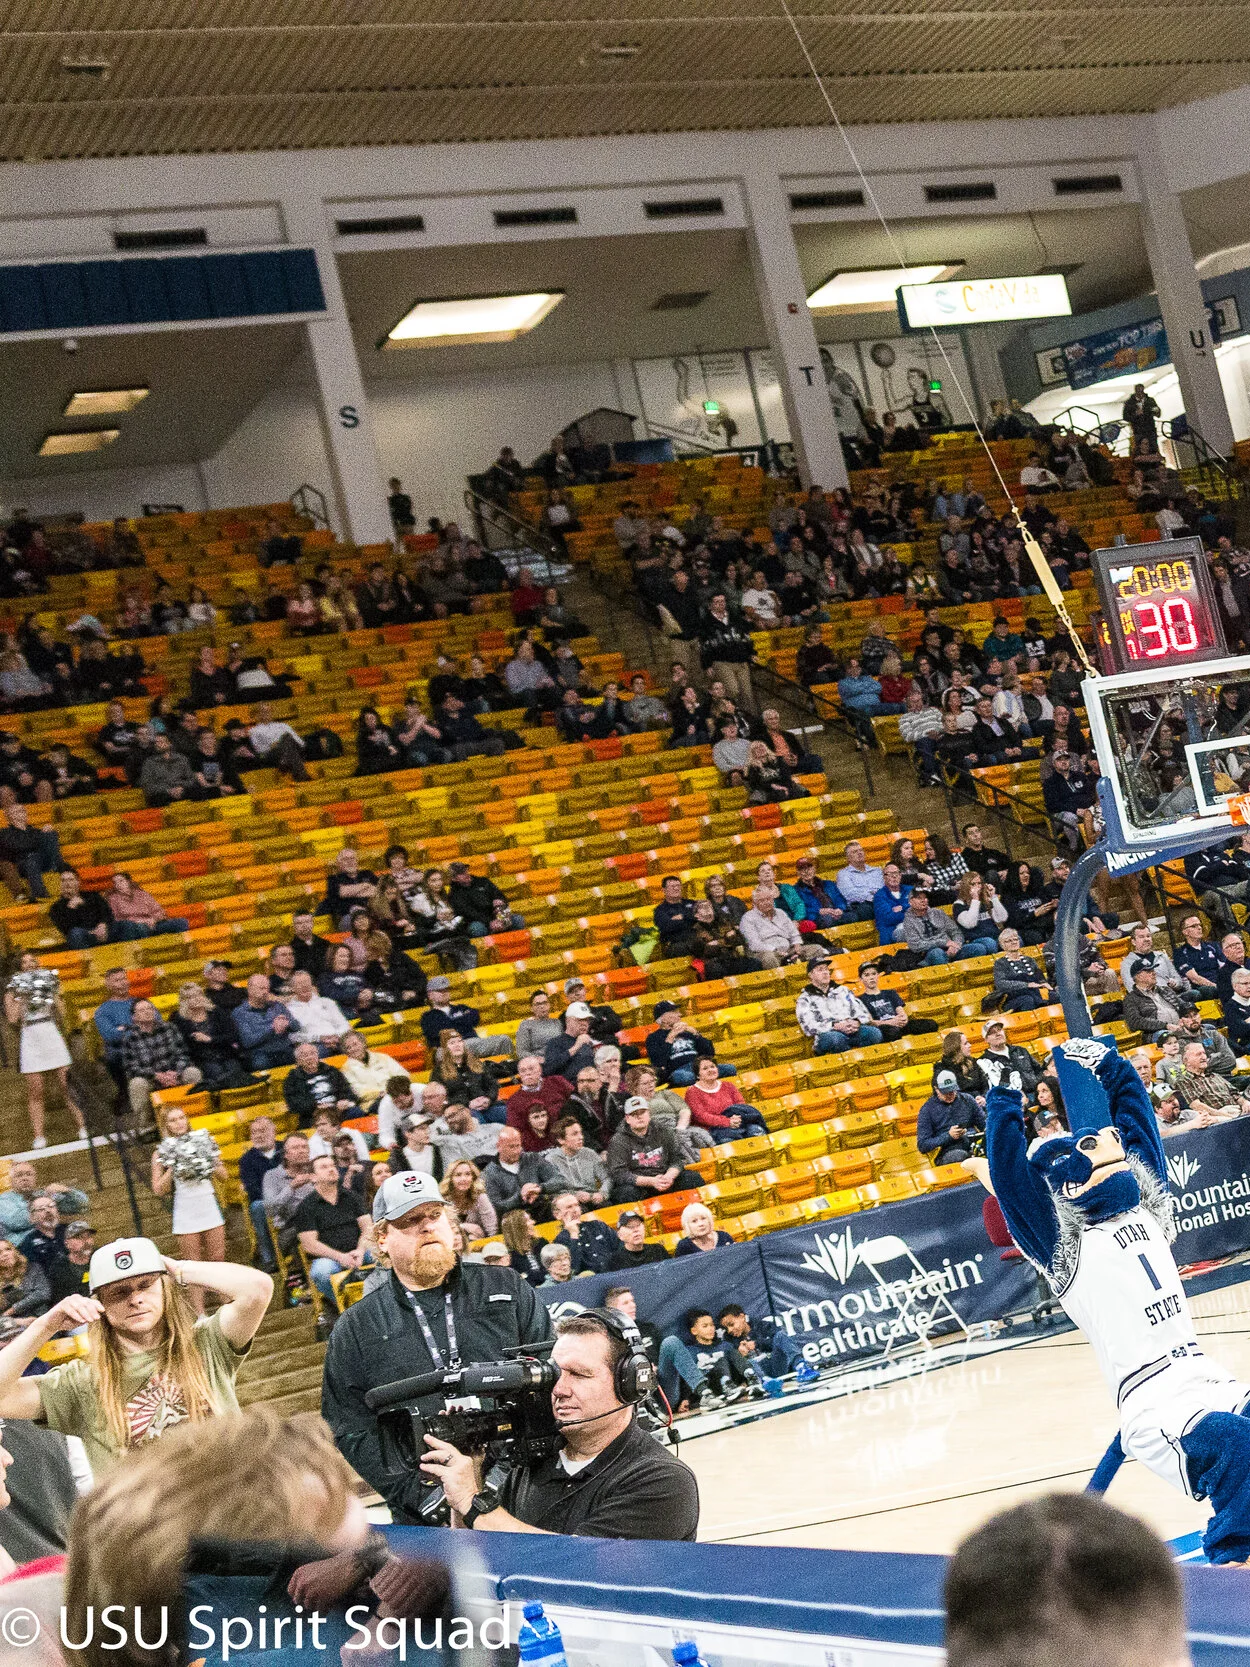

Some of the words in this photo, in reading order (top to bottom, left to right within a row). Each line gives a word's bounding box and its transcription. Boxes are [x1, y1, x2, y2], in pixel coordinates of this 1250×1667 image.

[1189, 329, 1206, 349] U
[799, 365, 814, 386] T
[339, 405, 359, 429] S
[1118, 561, 1193, 599] 20:00
[1134, 598, 1199, 657] 30
[1173, 1206, 1219, 1233] ional
[1112, 1222, 1151, 1250] UTAH
[1137, 1252, 1163, 1291] 1
[780, 1256, 984, 1337] rmountain
[1144, 1294, 1182, 1326] STATE
[802, 1310, 931, 1363] ealthcare
